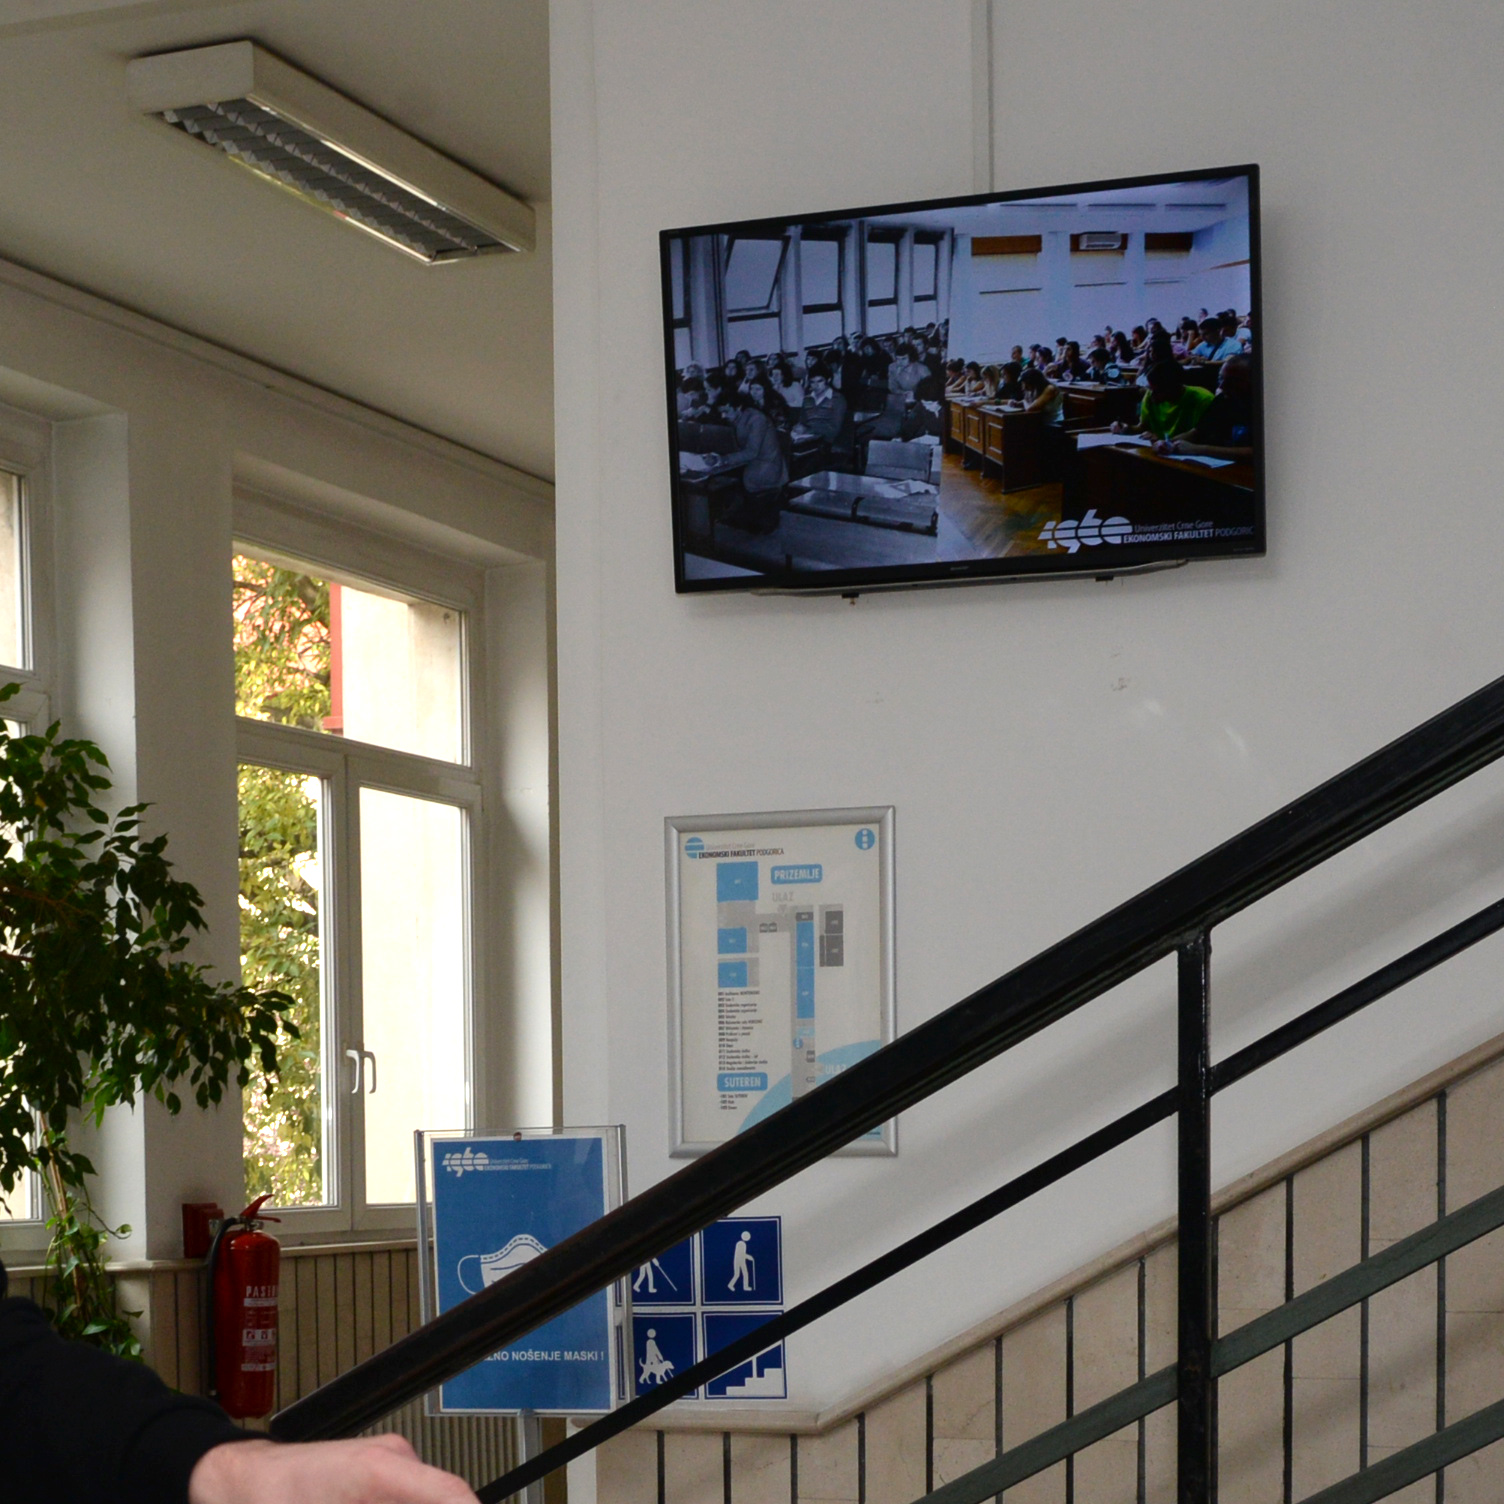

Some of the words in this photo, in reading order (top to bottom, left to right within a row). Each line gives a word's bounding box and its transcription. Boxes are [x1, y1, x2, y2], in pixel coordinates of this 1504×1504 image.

[1123, 532, 1173, 544] EKONOMSKI
[1174, 528, 1215, 541] FAKULTET
[774, 867, 821, 881] PRIZEMLJE
[724, 1076, 761, 1088] SUTEREN
[511, 1348, 561, 1361] NOŠENJE
[563, 1350, 599, 1361] MASKI
